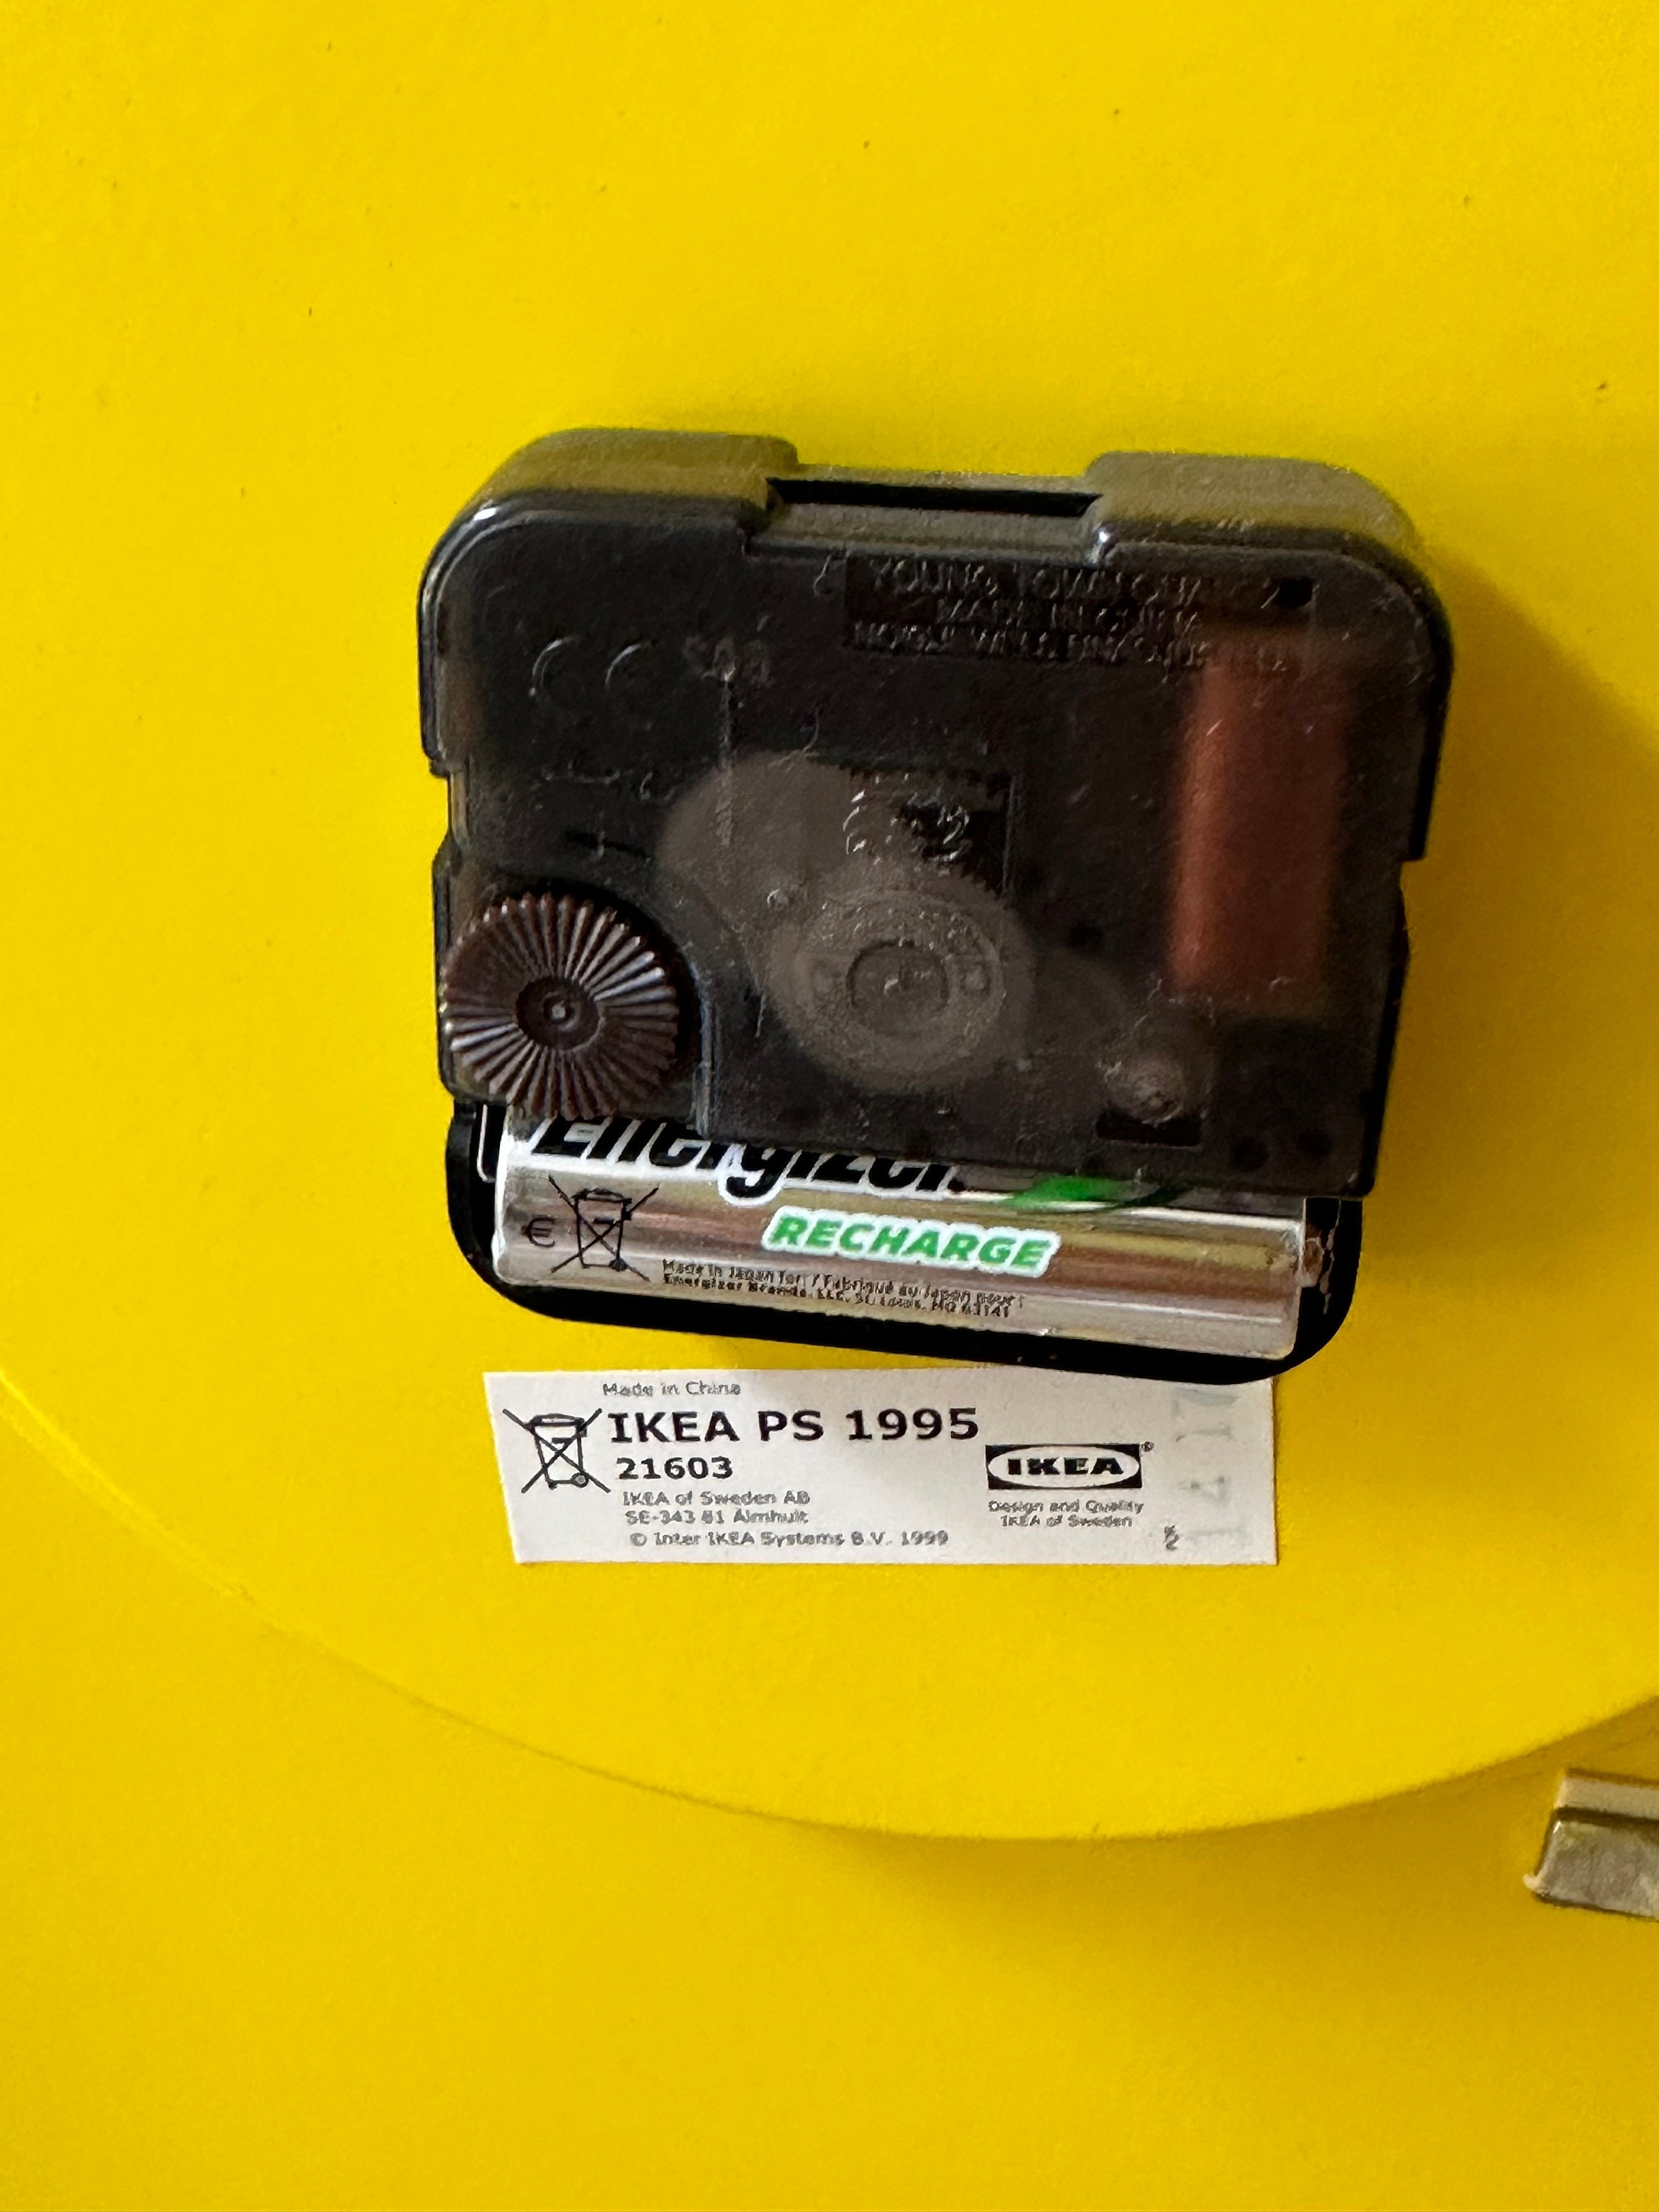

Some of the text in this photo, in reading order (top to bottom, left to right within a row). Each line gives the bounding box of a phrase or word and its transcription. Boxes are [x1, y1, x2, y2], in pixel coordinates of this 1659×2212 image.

[768, 1215, 1054, 1270] RECHARGE
[602, 1380, 742, 1397] Made in China
[607, 1407, 979, 1443] IKEA PS 1995
[616, 1455, 734, 1480] 21603
[1007, 1457, 1124, 1475] IKEA
[623, 1489, 811, 1506] IKEA of Sweden AB
[1049, 1500, 1080, 1513] and
[625, 1509, 696, 1525] SE-343
[1001, 1514, 1041, 1528] IKEA
[1068, 1514, 1133, 1528] Sweden
[653, 1531, 701, 1546] Inter
[706, 1531, 755, 1546] IKEA
[759, 1531, 846, 1548] Systems
[901, 1529, 950, 1546] 1999
